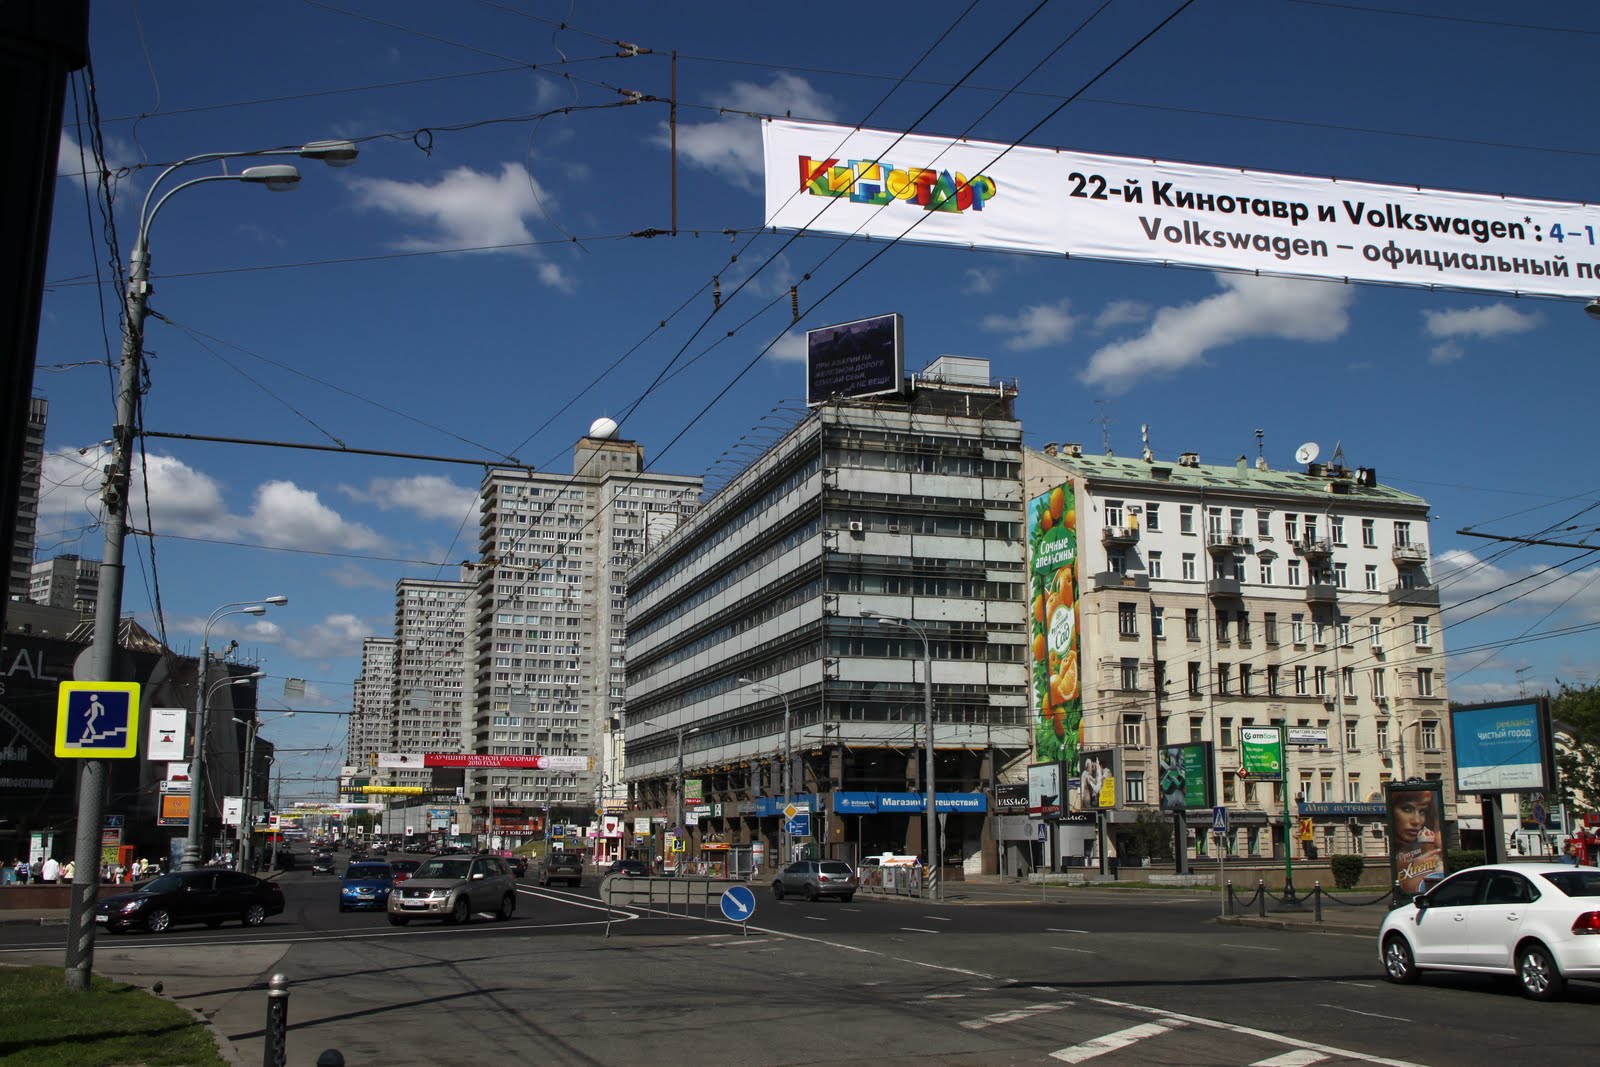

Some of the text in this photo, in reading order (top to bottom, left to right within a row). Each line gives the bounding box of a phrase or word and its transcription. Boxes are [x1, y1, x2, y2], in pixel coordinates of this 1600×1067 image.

[1068, 172, 1143, 204] 22-й
[1152, 181, 1309, 228] Кинотавр
[1317, 205, 1337, 222] и
[1138, 215, 1329, 259] Volkswagen
[1362, 239, 1569, 279] официальный
[854, 360, 885, 371] ДОРОГЕ
[1040, 537, 1069, 555] Сочные
[1035, 548, 1074, 568] апельсины
[1055, 622, 1070, 650] Сад
[0, 648, 58, 681] AL
[1477, 728, 1532, 740] чистый город
[882, 797, 979, 807] Магазин Птешествий
[1305, 803, 1329, 813] Мир
